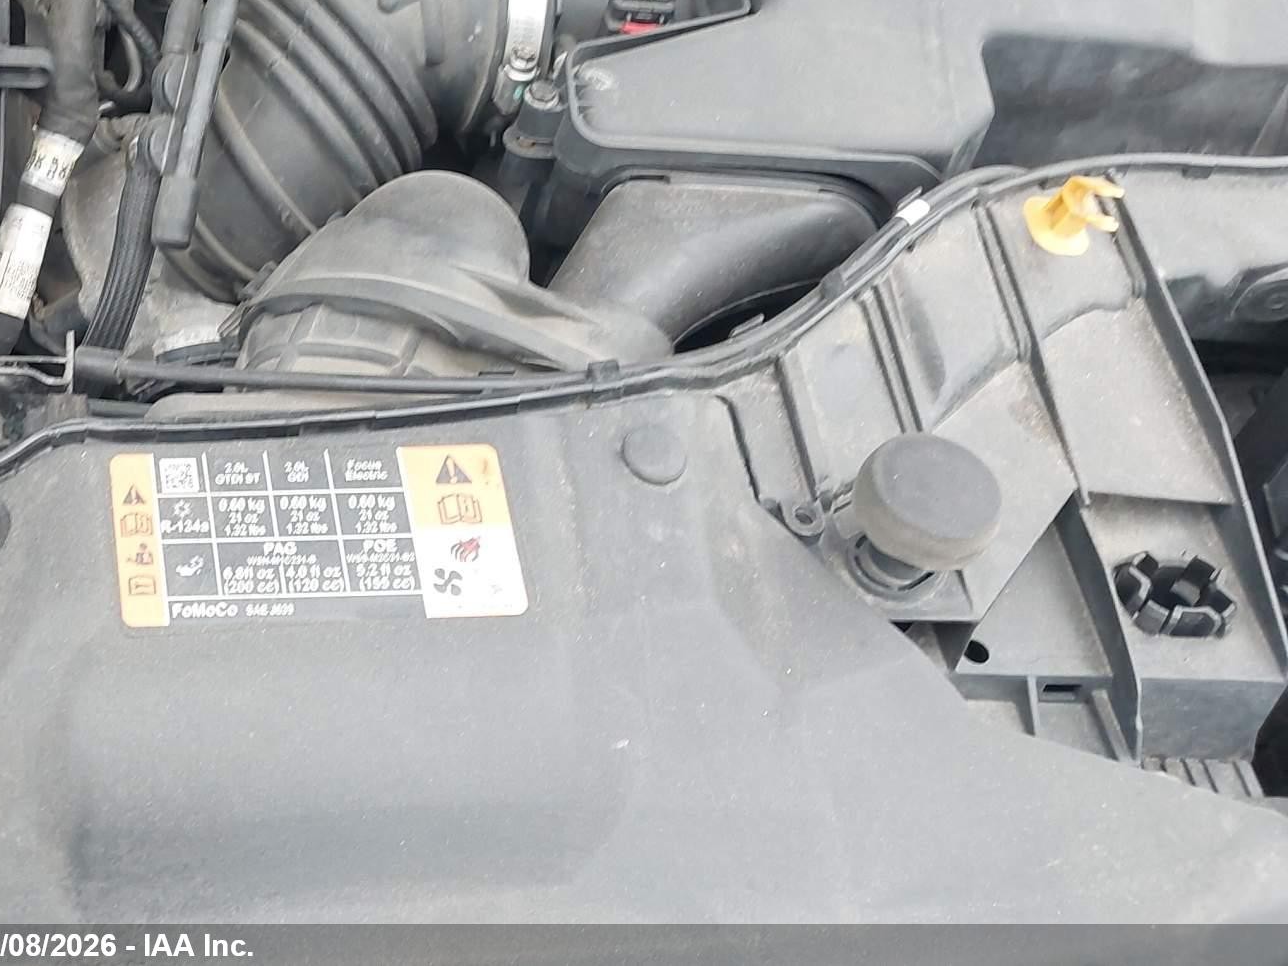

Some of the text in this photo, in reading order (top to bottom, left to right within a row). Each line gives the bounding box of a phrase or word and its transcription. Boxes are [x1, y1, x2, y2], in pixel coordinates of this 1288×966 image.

[247, 497, 266, 514] kg
[308, 495, 328, 512] kg
[348, 494, 396, 511] 0.60 kg
[262, 541, 298, 556] PAG
[362, 538, 398, 554] POE
[256, 567, 276, 580] oz
[323, 566, 342, 578] oz
[393, 564, 413, 576] oz
[223, 579, 280, 596] (200 cc)
[288, 577, 345, 594] (120 cc)
[392, 576, 416, 592] cc)
[171, 601, 239, 619] FoMoCo
